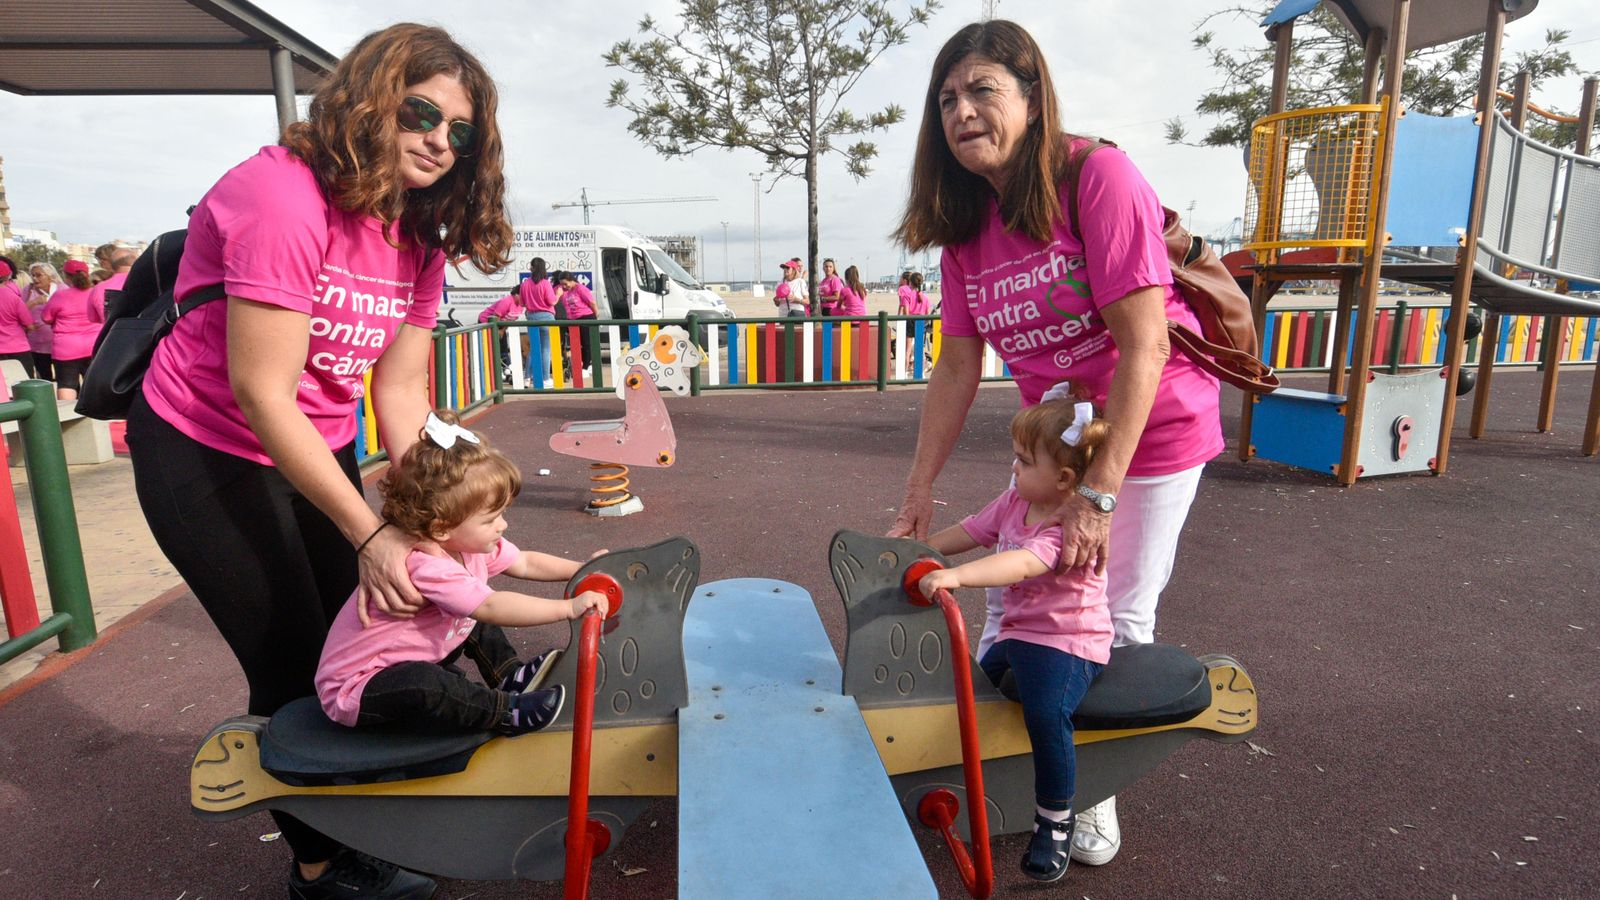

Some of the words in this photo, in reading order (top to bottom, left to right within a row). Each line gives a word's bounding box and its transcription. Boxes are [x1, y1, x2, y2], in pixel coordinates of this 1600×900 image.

[523, 231, 536, 241] DE
[535, 231, 580, 241] ALIMENTOS
[994, 250, 1087, 301] marcha
[309, 317, 387, 349] ontra
[976, 300, 1041, 335] ontra
